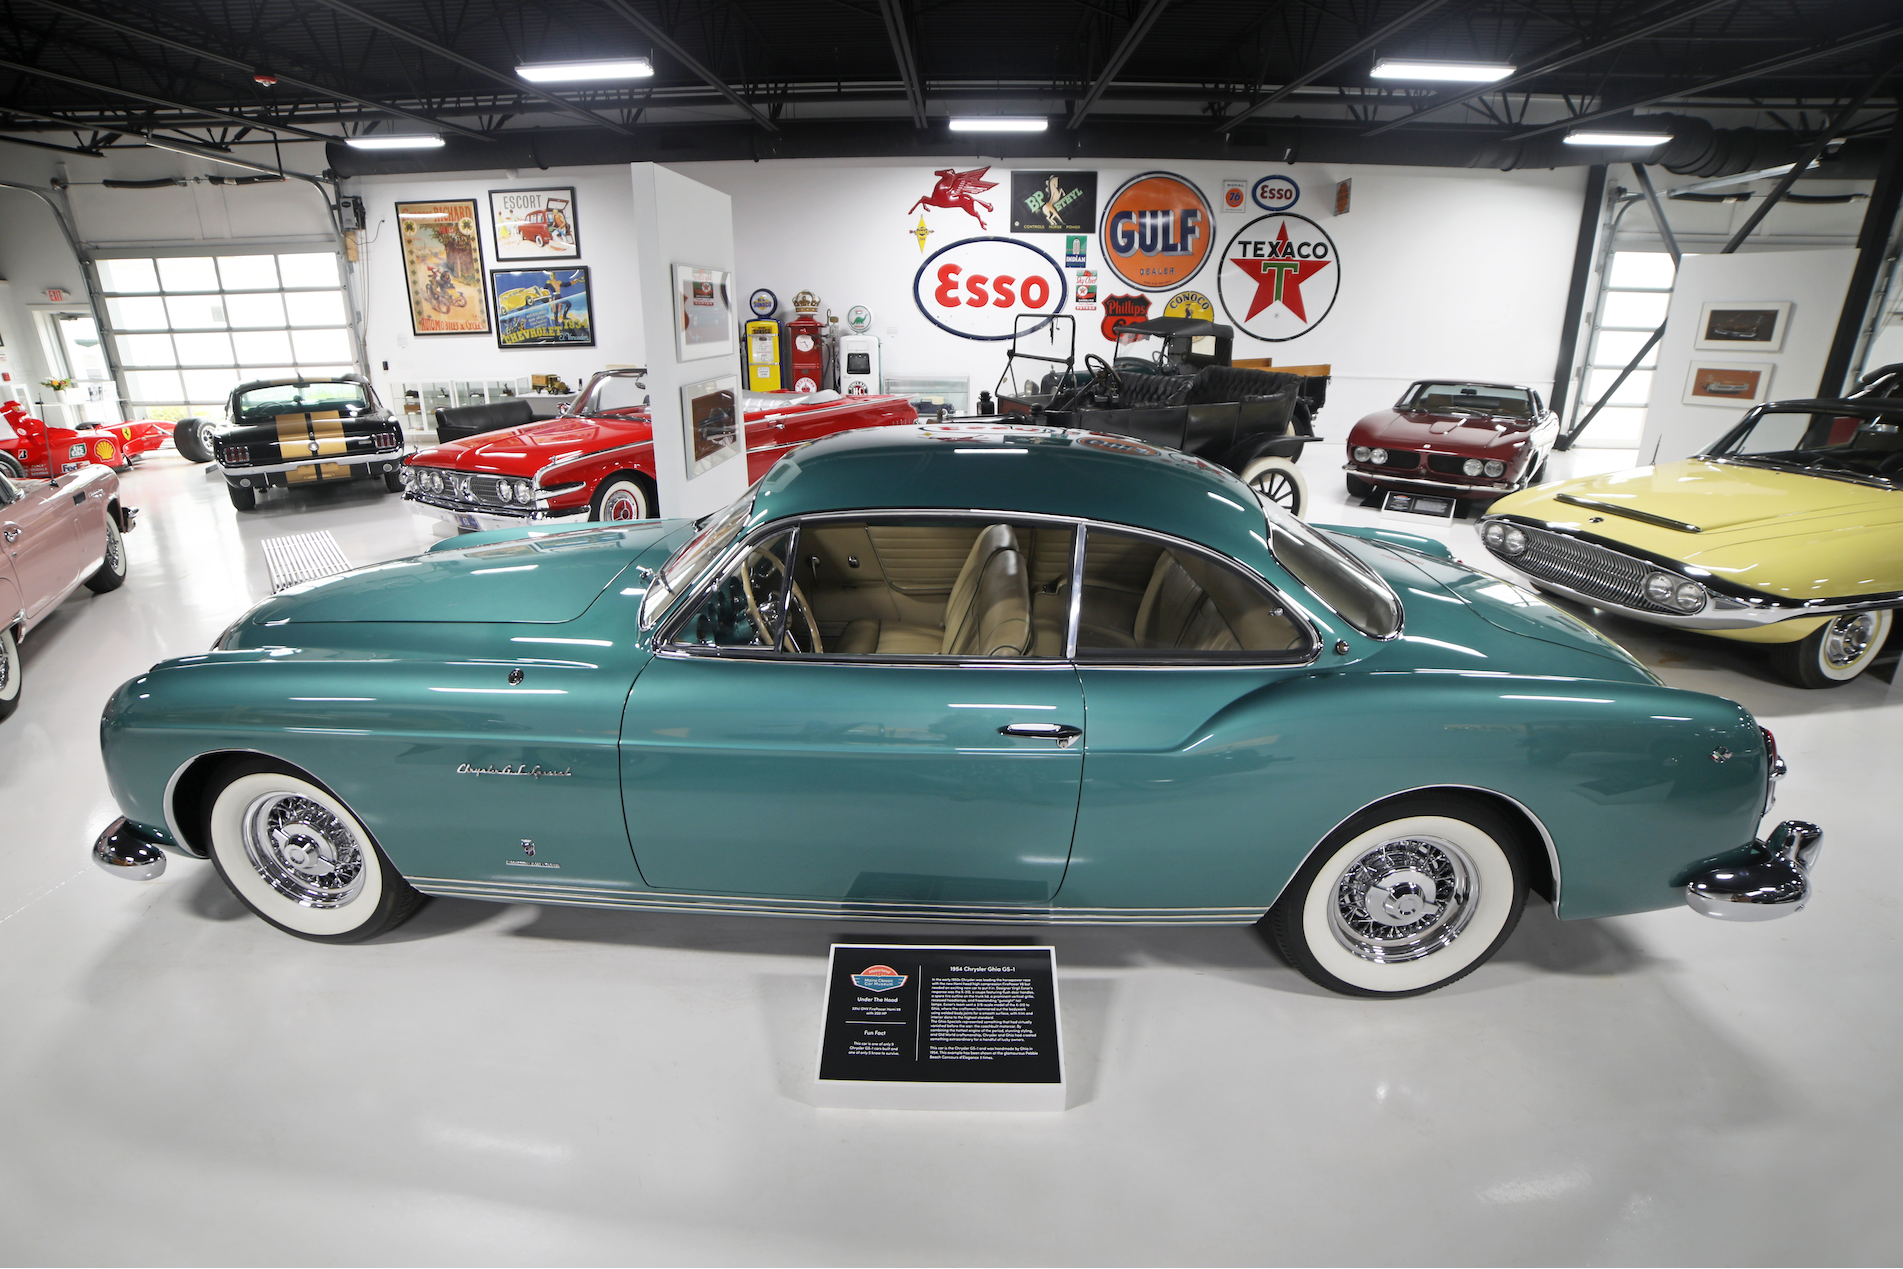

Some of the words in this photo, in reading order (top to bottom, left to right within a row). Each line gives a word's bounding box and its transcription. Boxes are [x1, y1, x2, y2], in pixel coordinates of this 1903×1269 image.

[1054, 188, 1083, 212] ETHYL
[1230, 192, 1240, 201] 76
[1260, 184, 1292, 200] Esso
[503, 195, 542, 209] ESCORT
[1024, 190, 1046, 212] BP
[434, 206, 472, 222] RICHARD
[1110, 209, 1202, 258] GULF
[1238, 241, 1328, 259] TEXACO
[935, 263, 1049, 308] Esso
[48, 290, 63, 301] EXIT
[1170, 293, 1210, 310] CONOCO
[1107, 300, 1146, 317] Phillips
[421, 318, 459, 331] AUTOMOBILES
[563, 319, 589, 329] 1934
[504, 326, 562, 344] CHEVROLET
